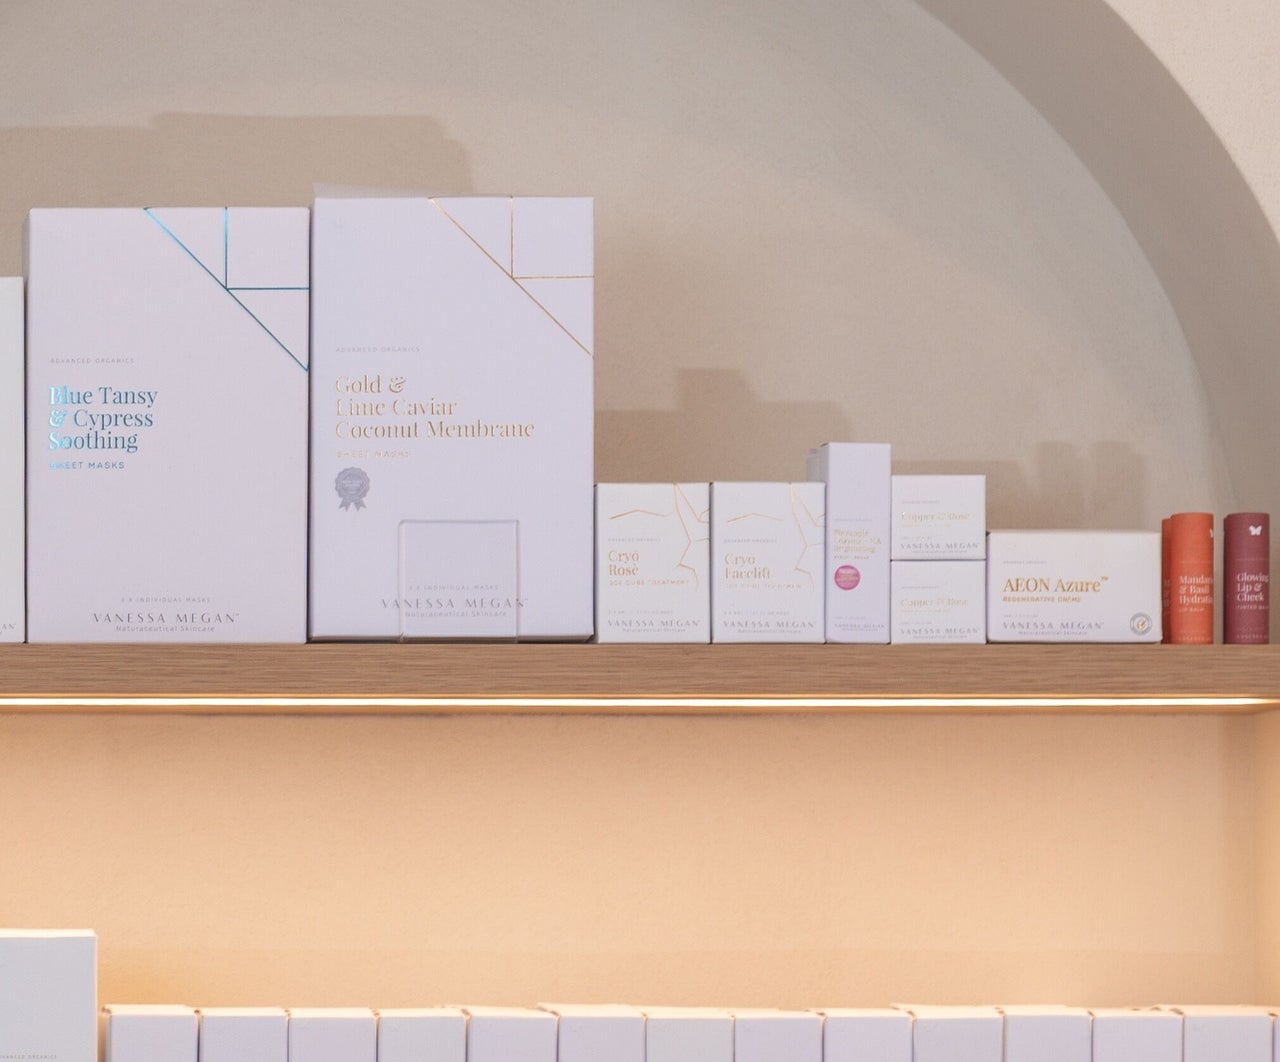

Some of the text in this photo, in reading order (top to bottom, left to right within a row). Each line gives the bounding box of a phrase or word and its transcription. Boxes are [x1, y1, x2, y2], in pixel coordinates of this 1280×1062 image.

[335, 374, 408, 394] Gold &
[49, 386, 158, 408] Blue Tansy
[336, 397, 458, 417] Lime Caviar
[48, 408, 154, 431] & Cypress
[335, 419, 535, 439] Coconut Membrane
[48, 430, 139, 454] Soothing
[49, 461, 126, 470] SHEET MASKS
[1002, 577, 1051, 593] AEON
[1237, 583, 1263, 594] Lip &
[380, 597, 456, 609] VANESSA
[1236, 591, 1265, 602] Cheek
[93, 612, 166, 624] VANESSA
[180, 624, 216, 633] Skincare
